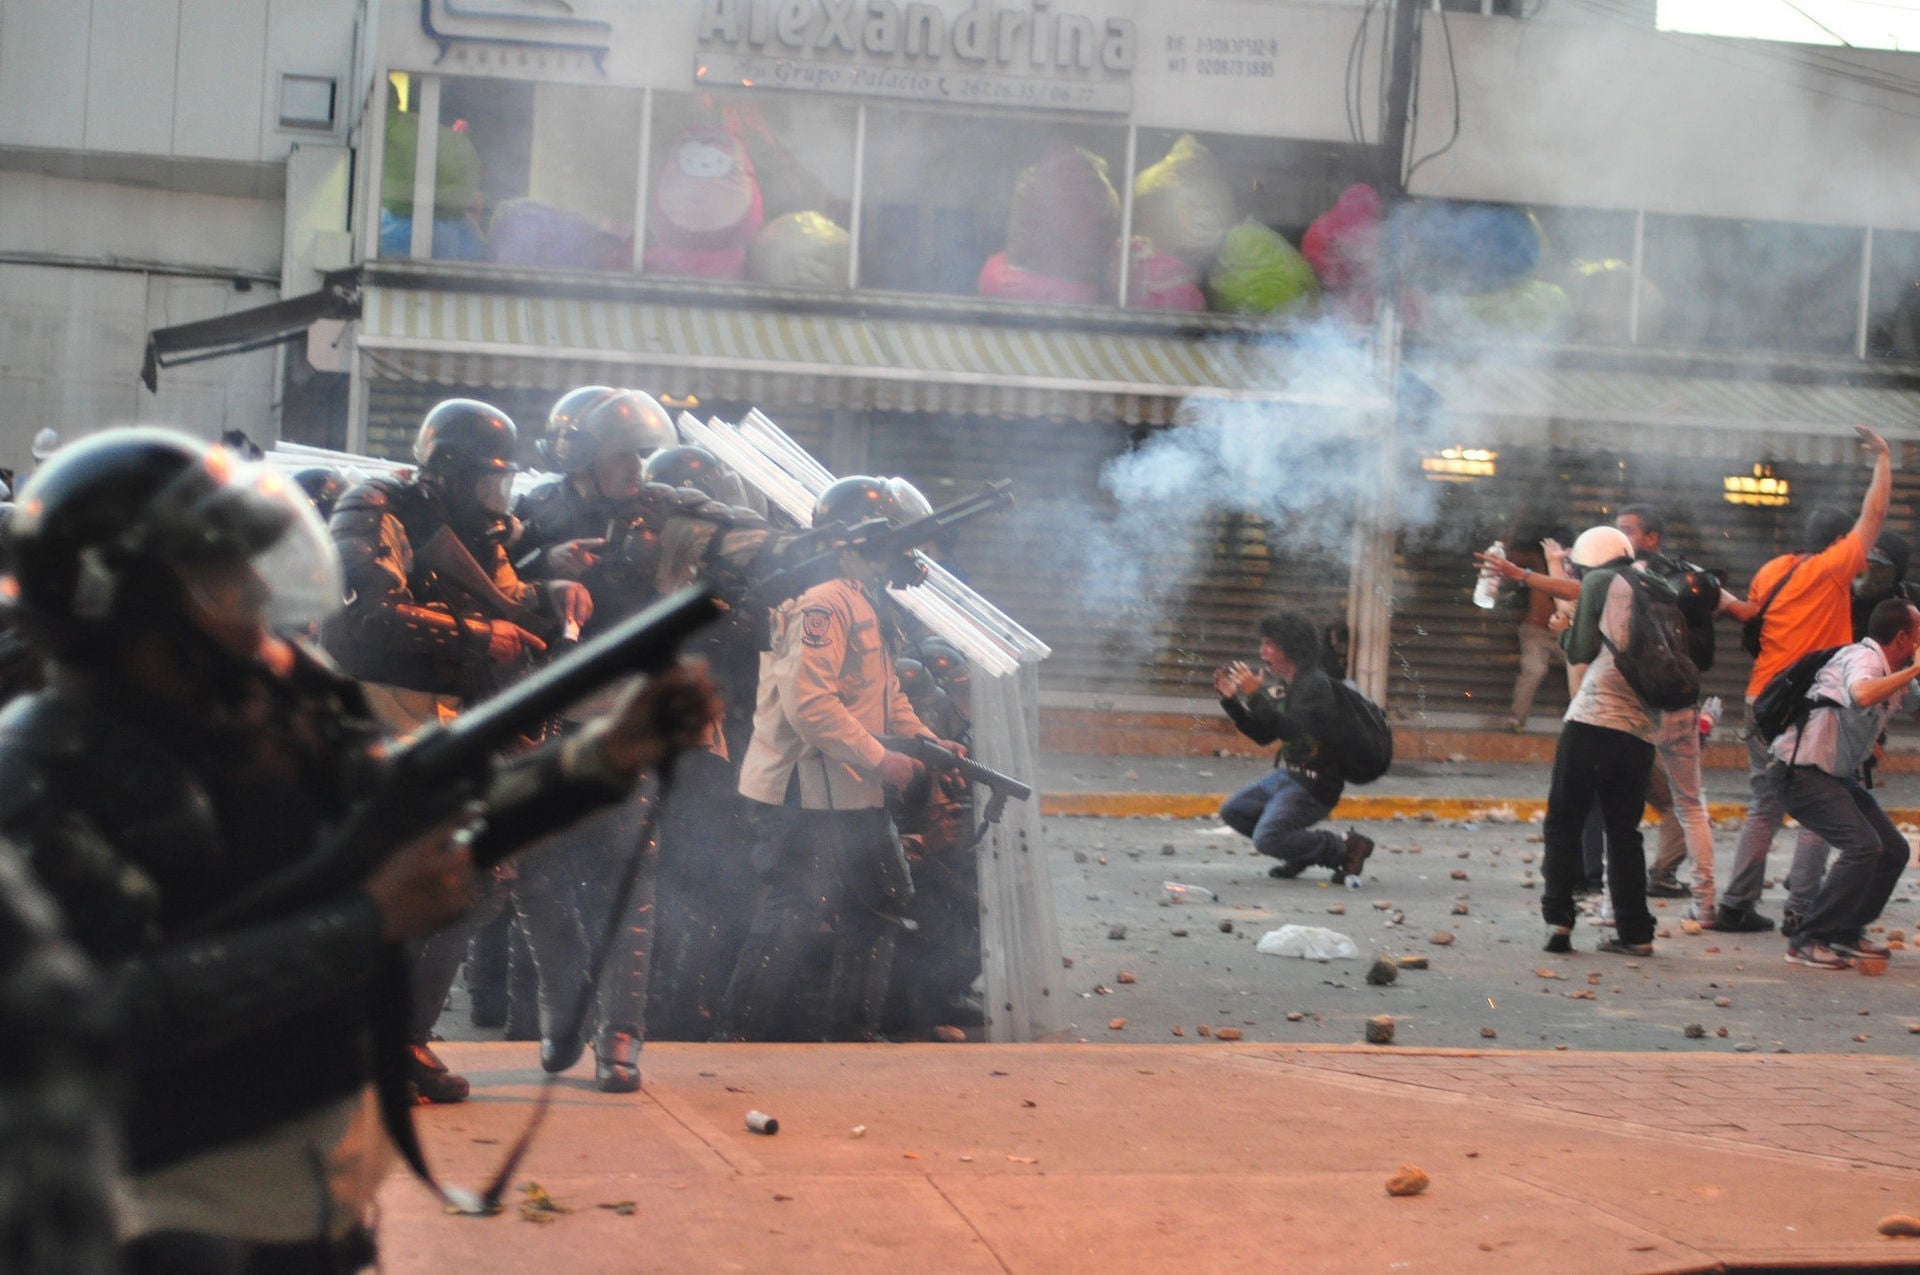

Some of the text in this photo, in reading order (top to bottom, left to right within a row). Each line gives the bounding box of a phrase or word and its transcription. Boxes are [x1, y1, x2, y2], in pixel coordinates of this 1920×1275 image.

[696, 0, 1136, 74] Alexandrina
[775, 60, 841, 89] Grupo
[850, 66, 931, 92] Palacio
